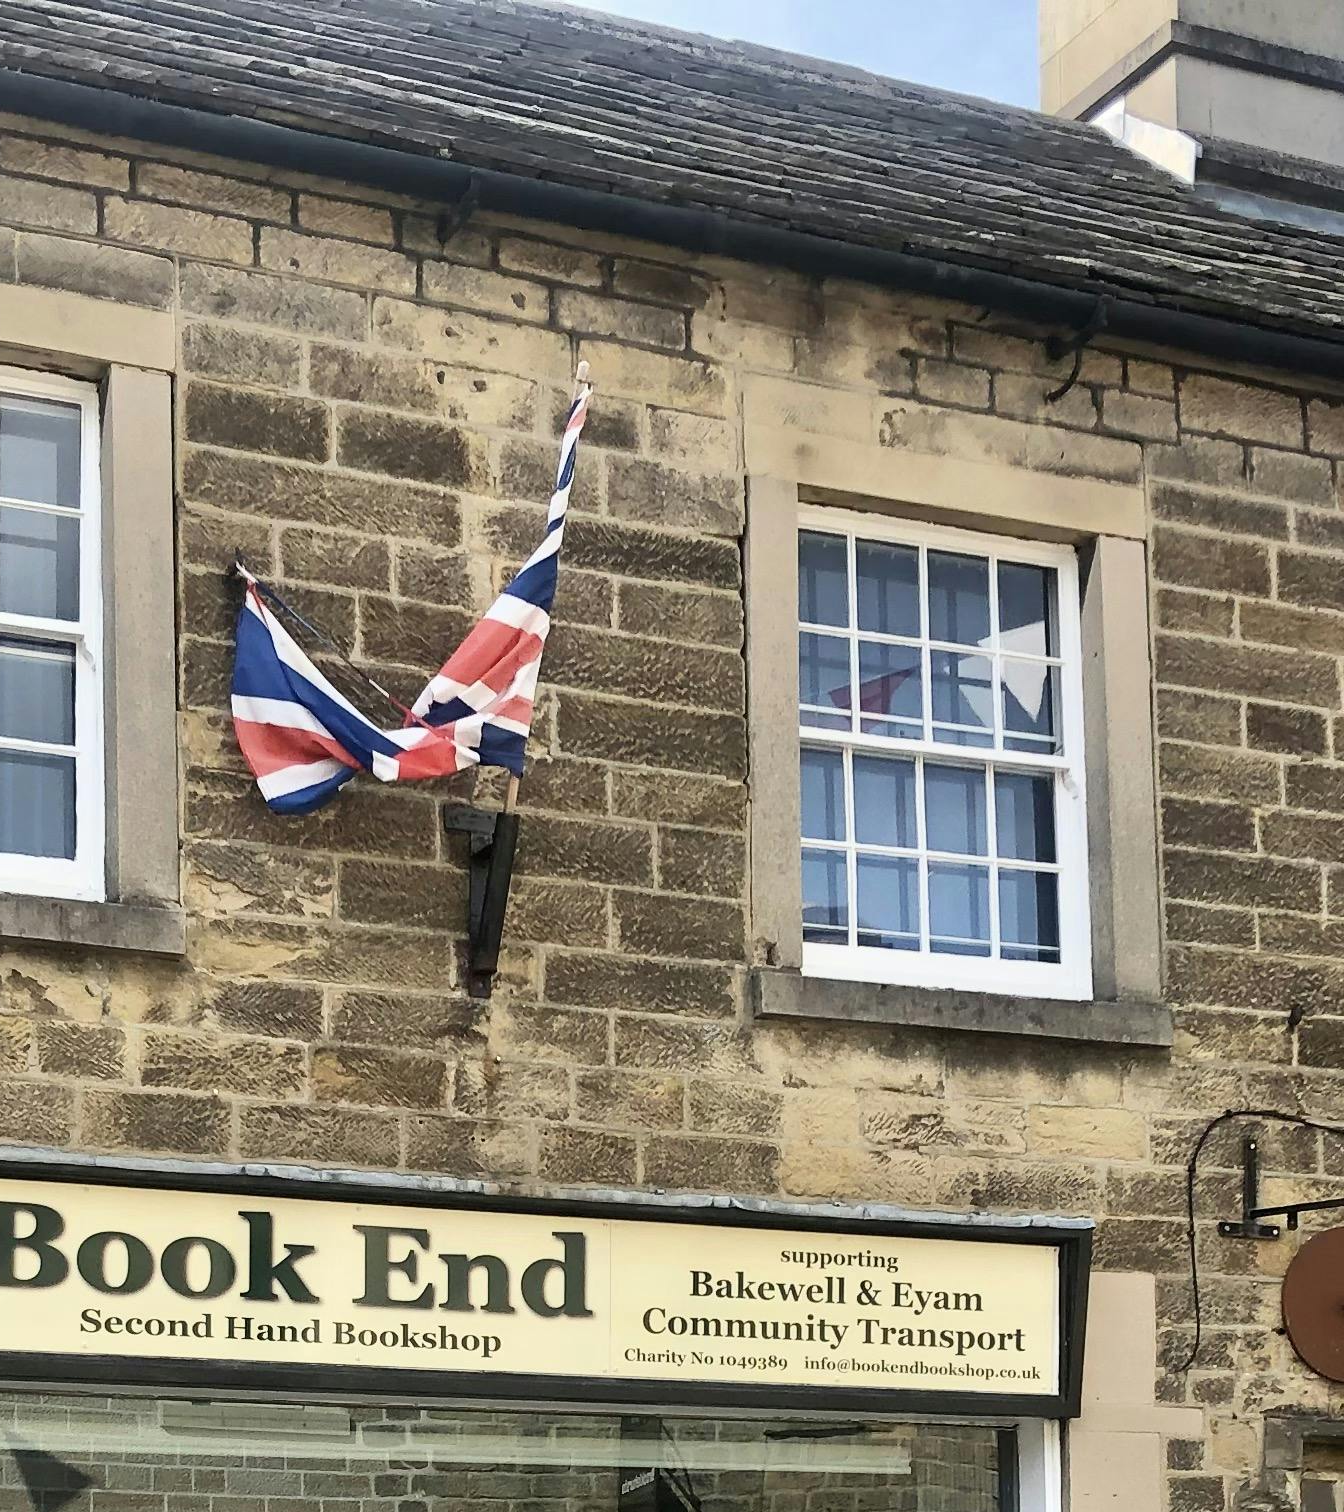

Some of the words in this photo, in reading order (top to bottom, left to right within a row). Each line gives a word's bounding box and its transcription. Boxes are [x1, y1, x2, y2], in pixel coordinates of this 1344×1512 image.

[351, 1222, 594, 1319] End
[780, 1248, 899, 1274] supporting
[689, 1269, 846, 1305] Bakewell
[856, 1279, 882, 1306] &
[891, 1281, 984, 1315] Eyam
[79, 1308, 215, 1341] Second
[225, 1314, 322, 1347] Hand
[332, 1320, 503, 1359] Bookshop
[642, 1307, 850, 1349] Community
[857, 1317, 1026, 1356] Transport
[624, 1347, 687, 1367] Charity
[691, 1350, 714, 1366] No
[718, 1352, 789, 1371] 1049389
[803, 1355, 1042, 1381] info@bookendbookshop.co.uk
